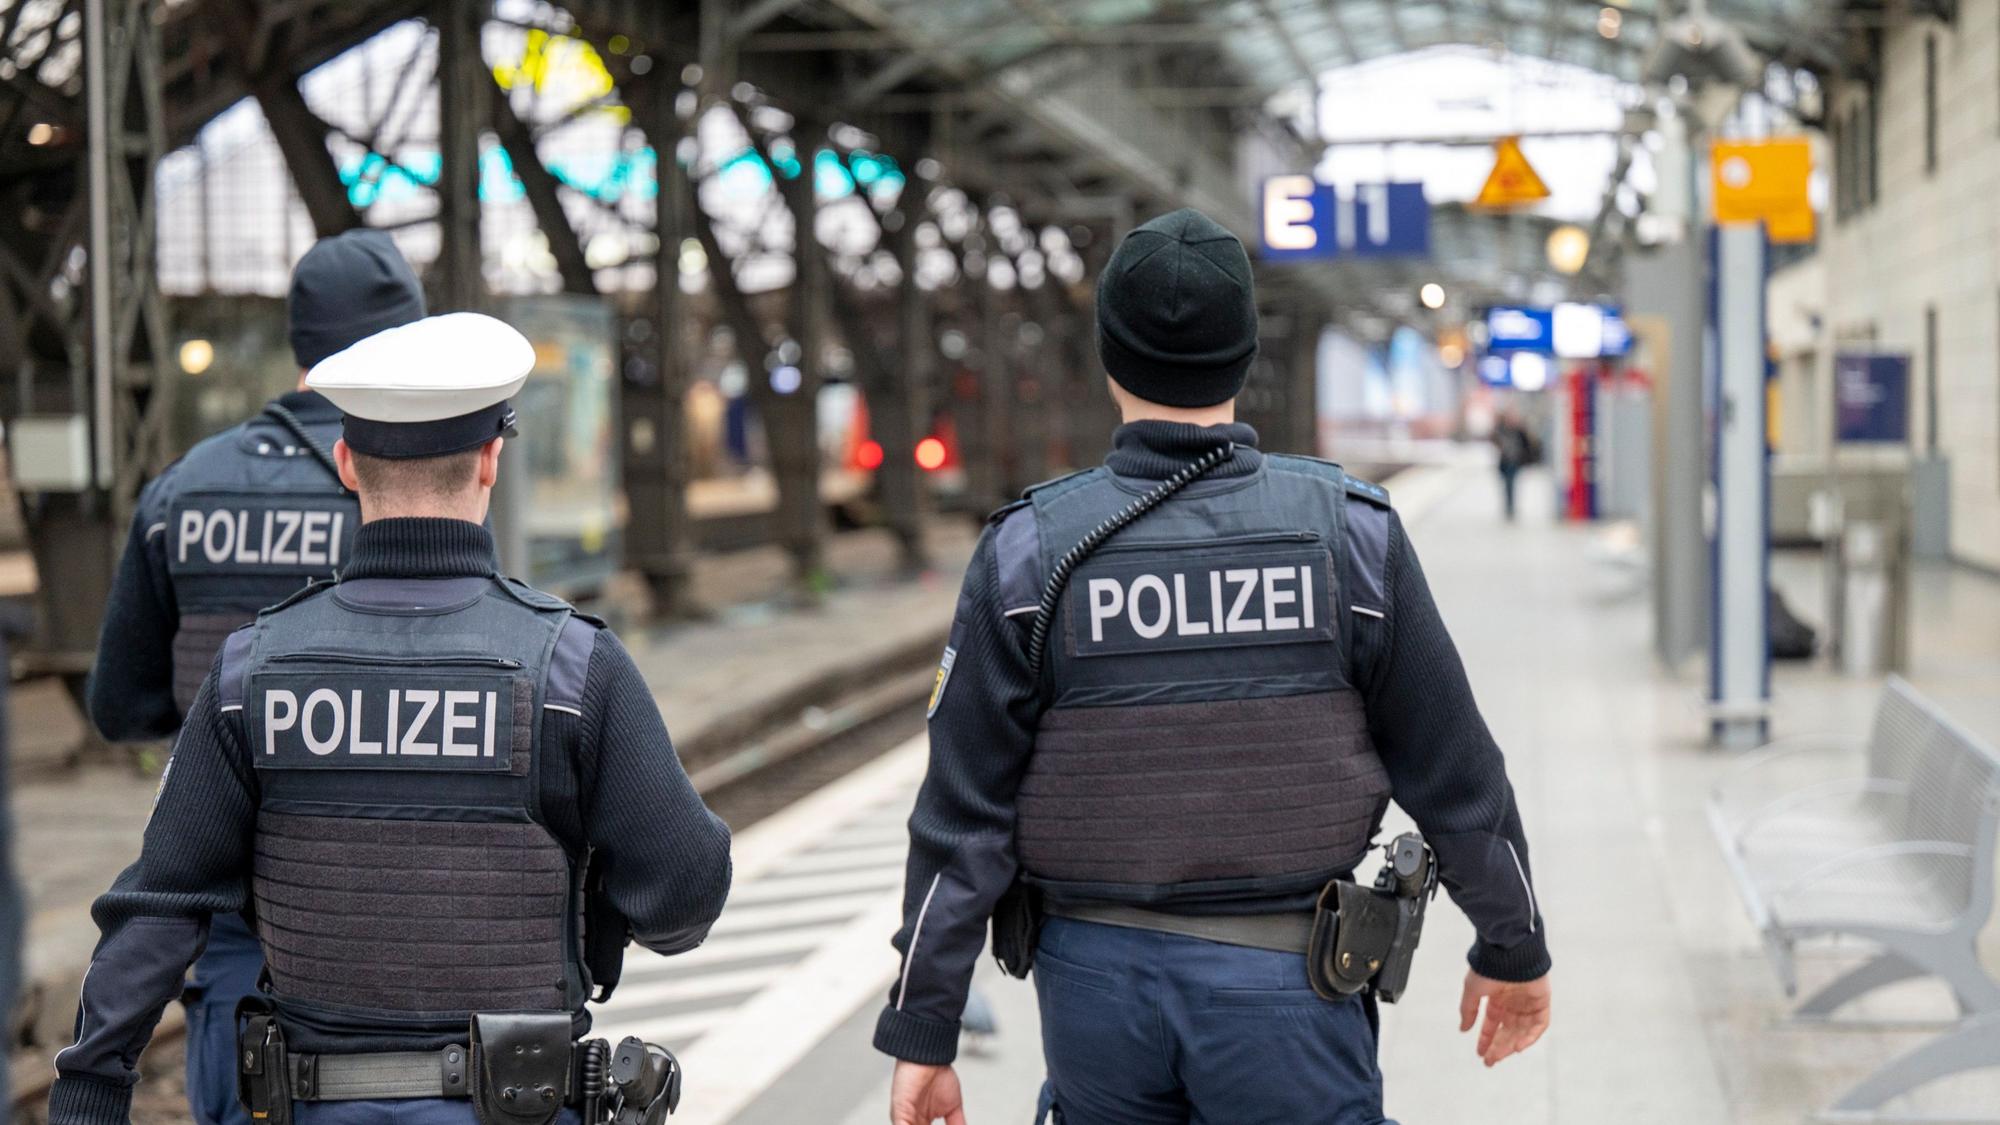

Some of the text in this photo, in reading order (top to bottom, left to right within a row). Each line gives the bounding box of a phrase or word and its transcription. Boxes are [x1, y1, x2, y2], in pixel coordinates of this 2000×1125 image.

[1264, 175, 1317, 249] E
[178, 509, 344, 565] POLIZEI
[1089, 565, 1315, 642] POLIZEI
[265, 688, 497, 757] POLIZEI
